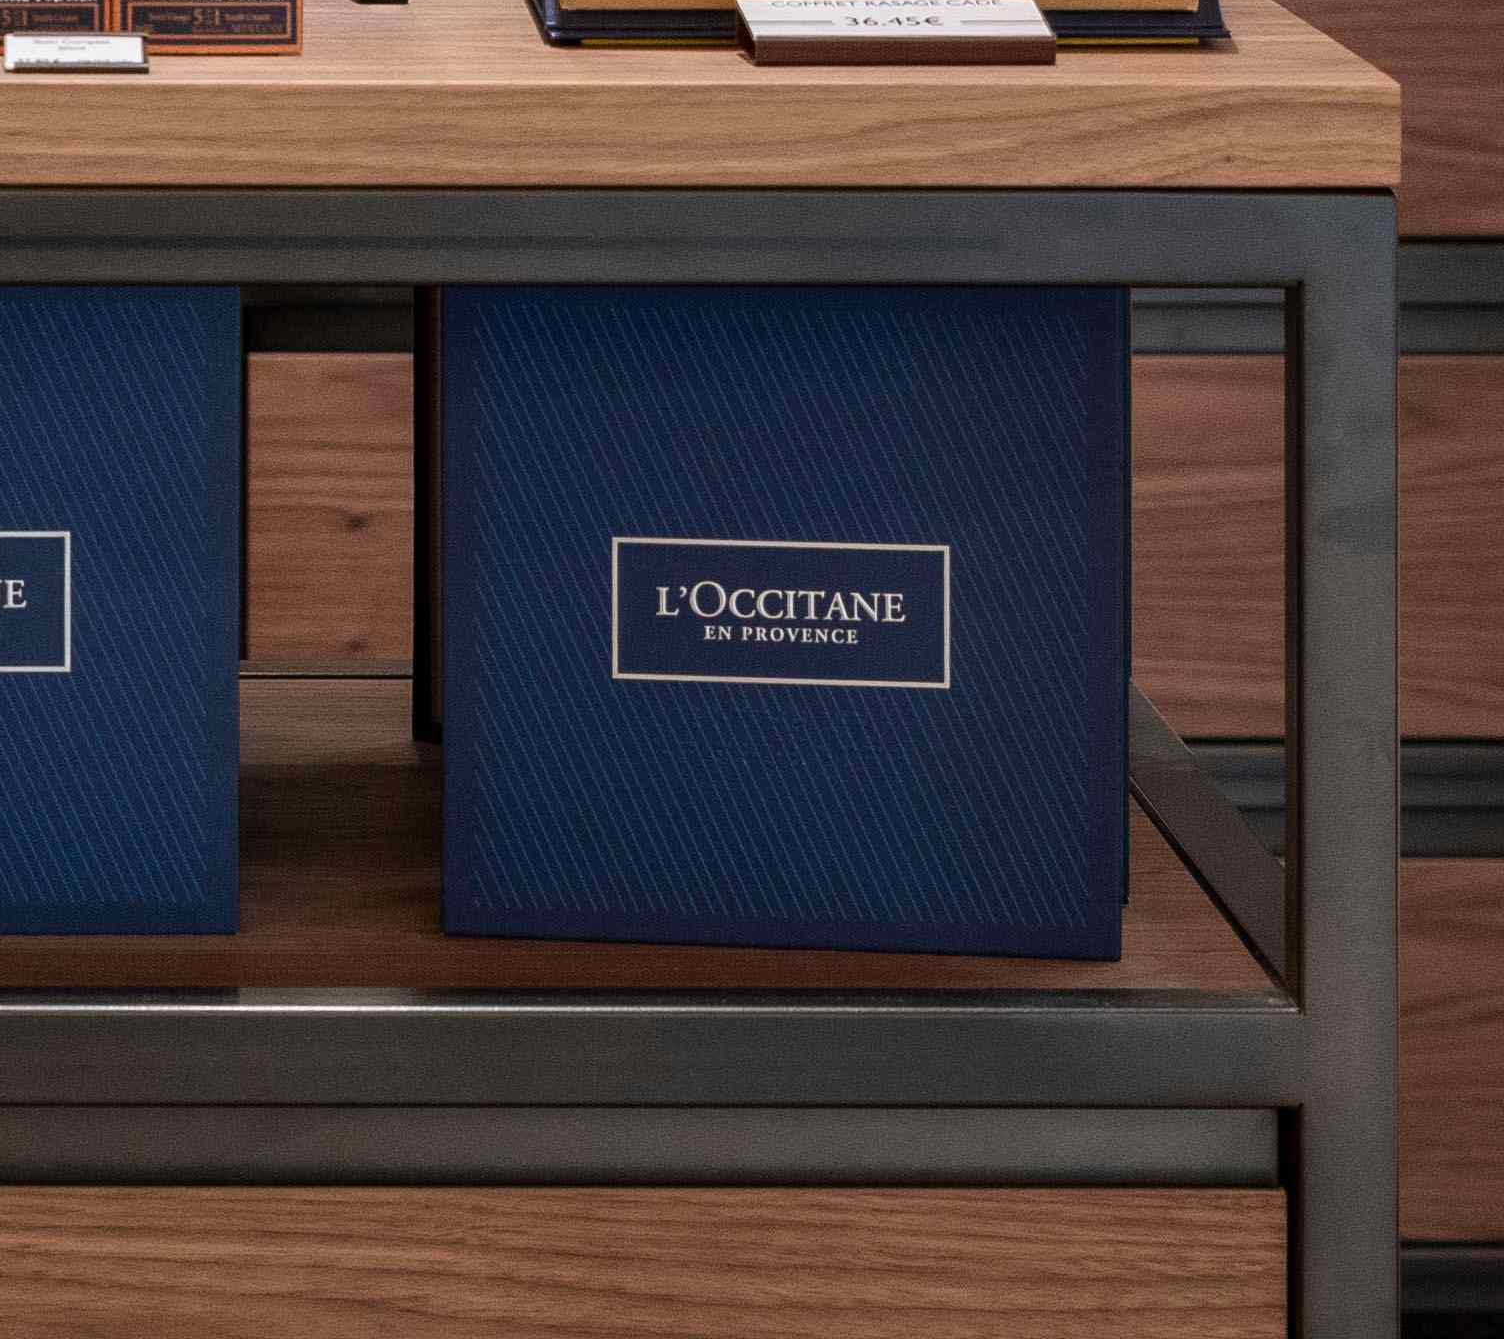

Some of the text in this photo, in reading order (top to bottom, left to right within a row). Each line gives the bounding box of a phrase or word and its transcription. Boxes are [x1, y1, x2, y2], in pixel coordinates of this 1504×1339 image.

[771, 0, 1001, 8] COFFRET RASAGE CADE
[845, 16, 943, 27] 36.45€
[655, 580, 906, 623] L'OCCITANE
[704, 625, 859, 644] EN PROVENCE
